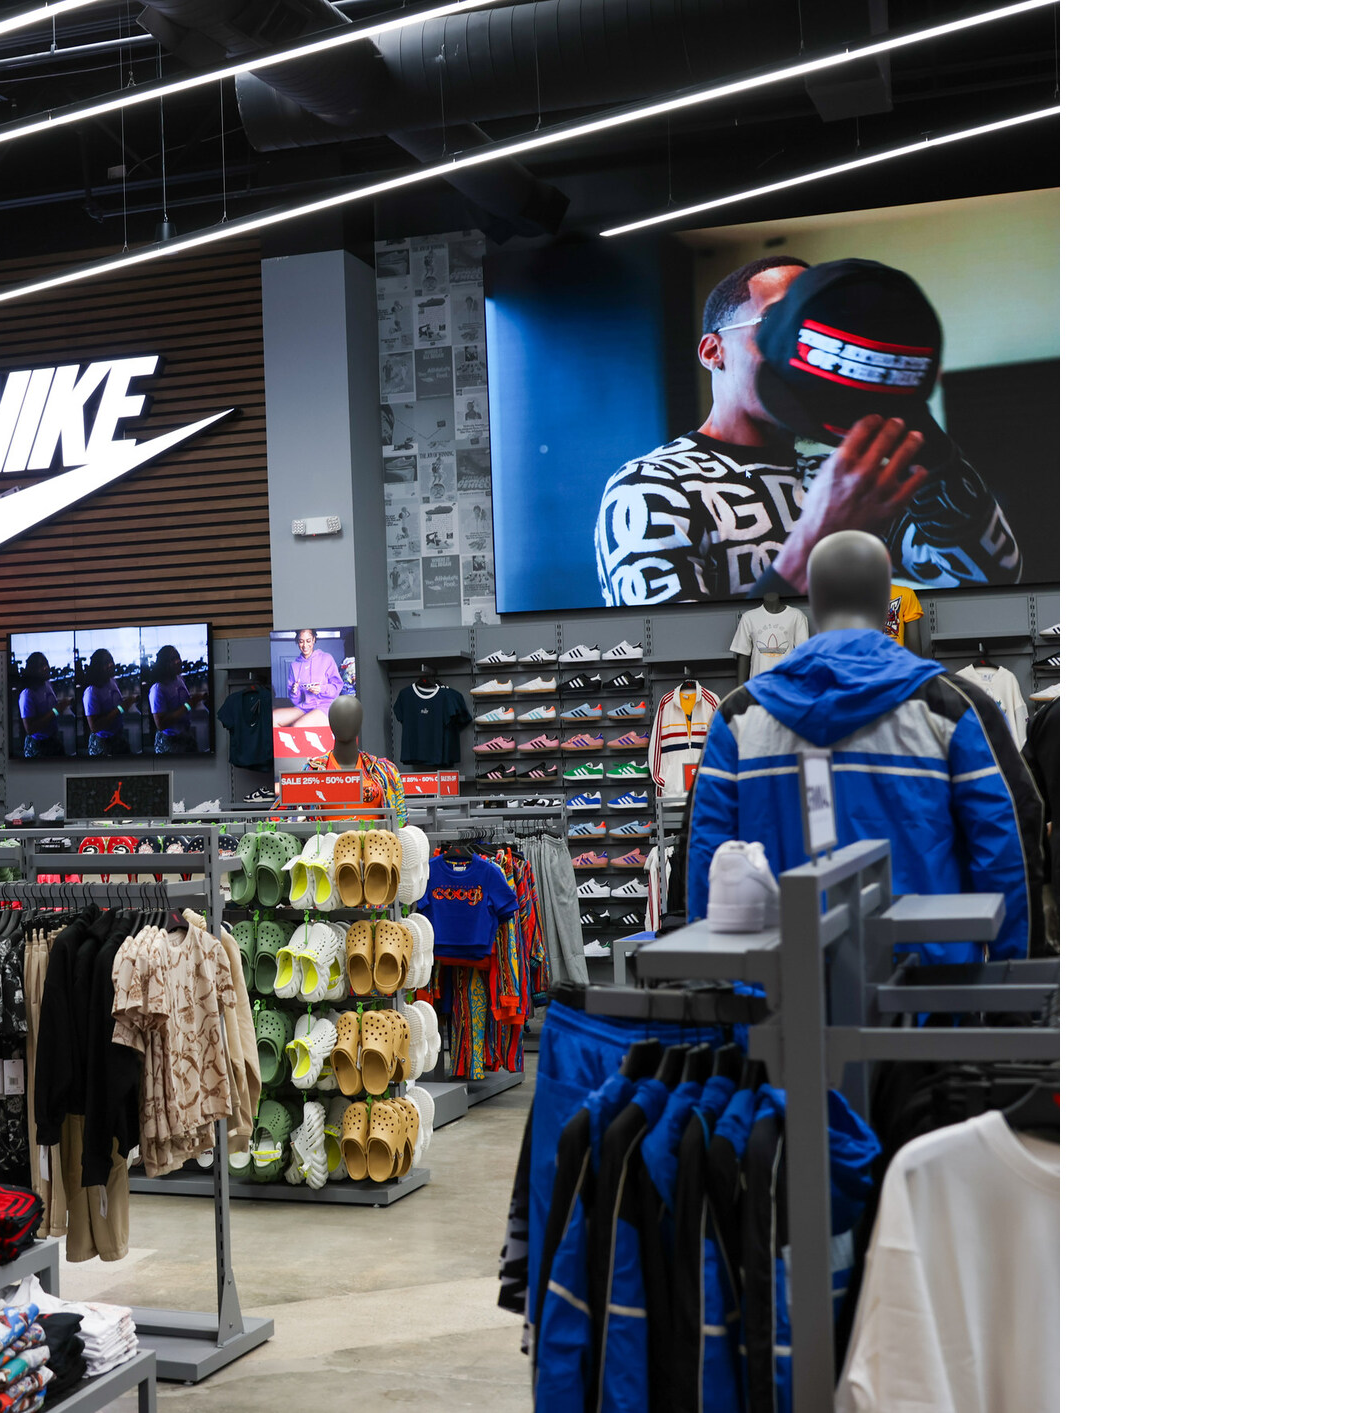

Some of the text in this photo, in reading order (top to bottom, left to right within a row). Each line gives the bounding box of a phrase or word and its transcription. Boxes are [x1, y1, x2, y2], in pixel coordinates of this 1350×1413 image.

[281, 777, 302, 786] SALE
[302, 777, 321, 785] 25%
[325, 776, 344, 784] 50%
[344, 775, 361, 784] OFF
